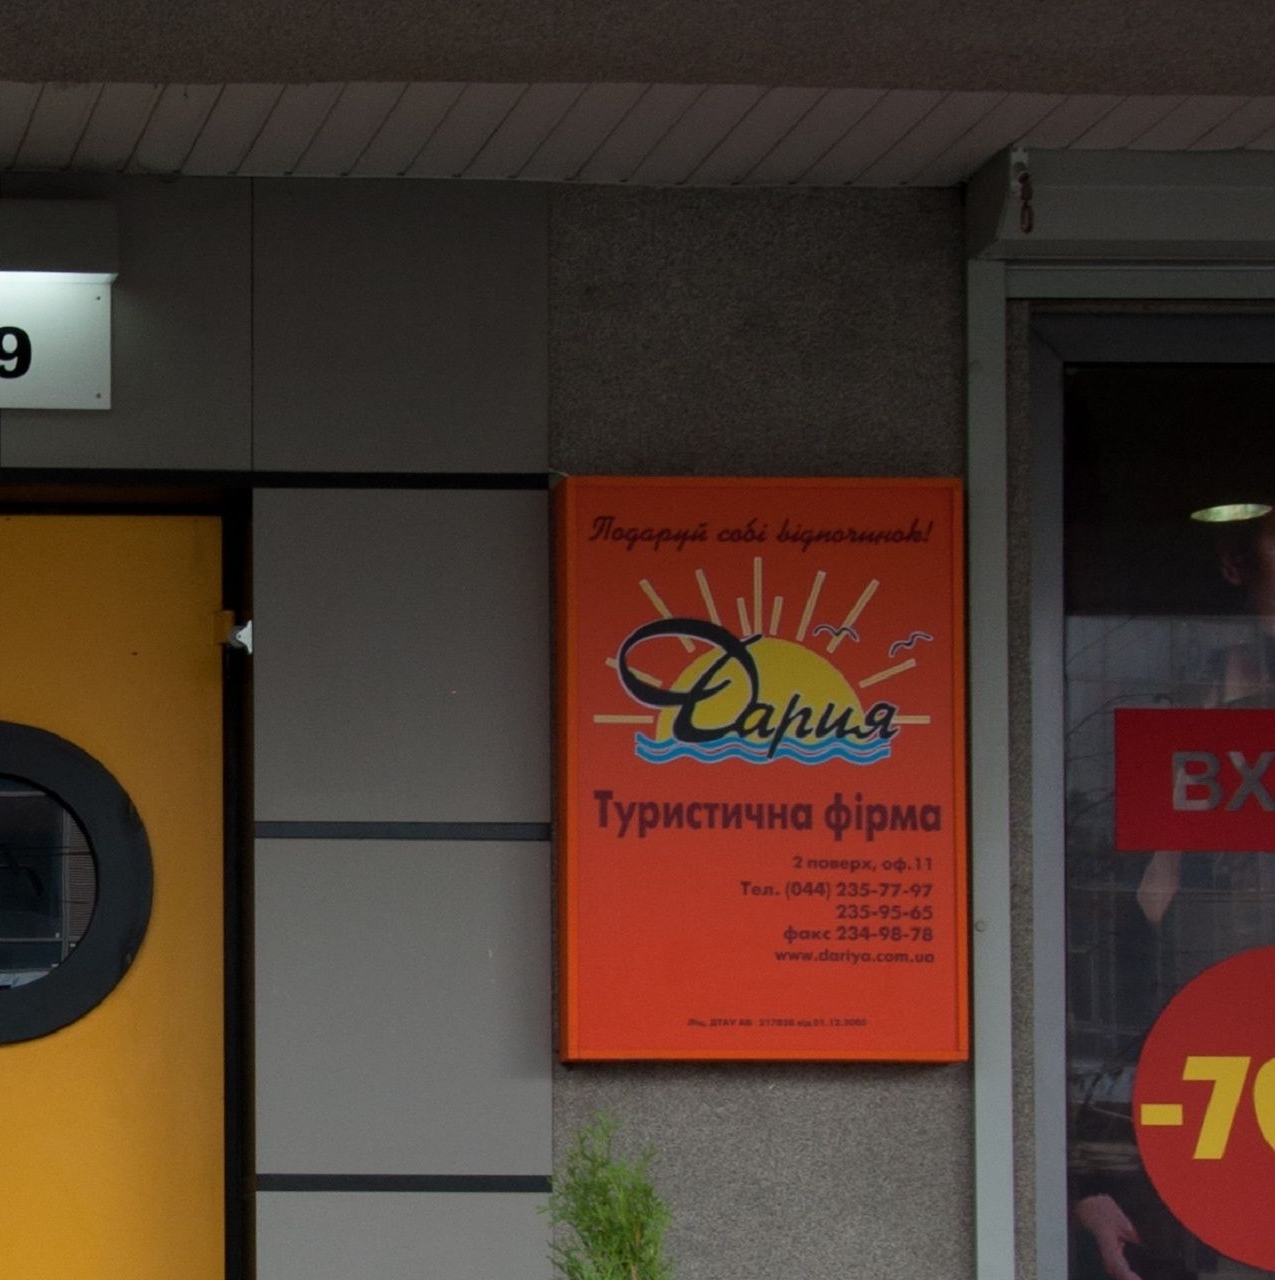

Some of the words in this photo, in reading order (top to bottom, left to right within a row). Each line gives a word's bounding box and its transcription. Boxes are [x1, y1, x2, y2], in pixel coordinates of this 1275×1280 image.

[588, 516, 709, 552] Подаруй
[716, 517, 769, 543] собі
[618, 617, 898, 759] Дария
[592, 789, 813, 838] Туристична
[823, 792, 942, 841] фірма
[793, 855, 803, 869] 2
[807, 857, 877, 873] поверх,
[740, 881, 780, 897] Тел.
[785, 881, 831, 901] (044)
[836, 882, 933, 897] 235-77-97
[836, 904, 934, 920] 235-95-65
[783, 925, 831, 945] факс
[835, 925, 934, 942] 234-98-78
[774, 949, 935, 966] www.dariya.com.ua
